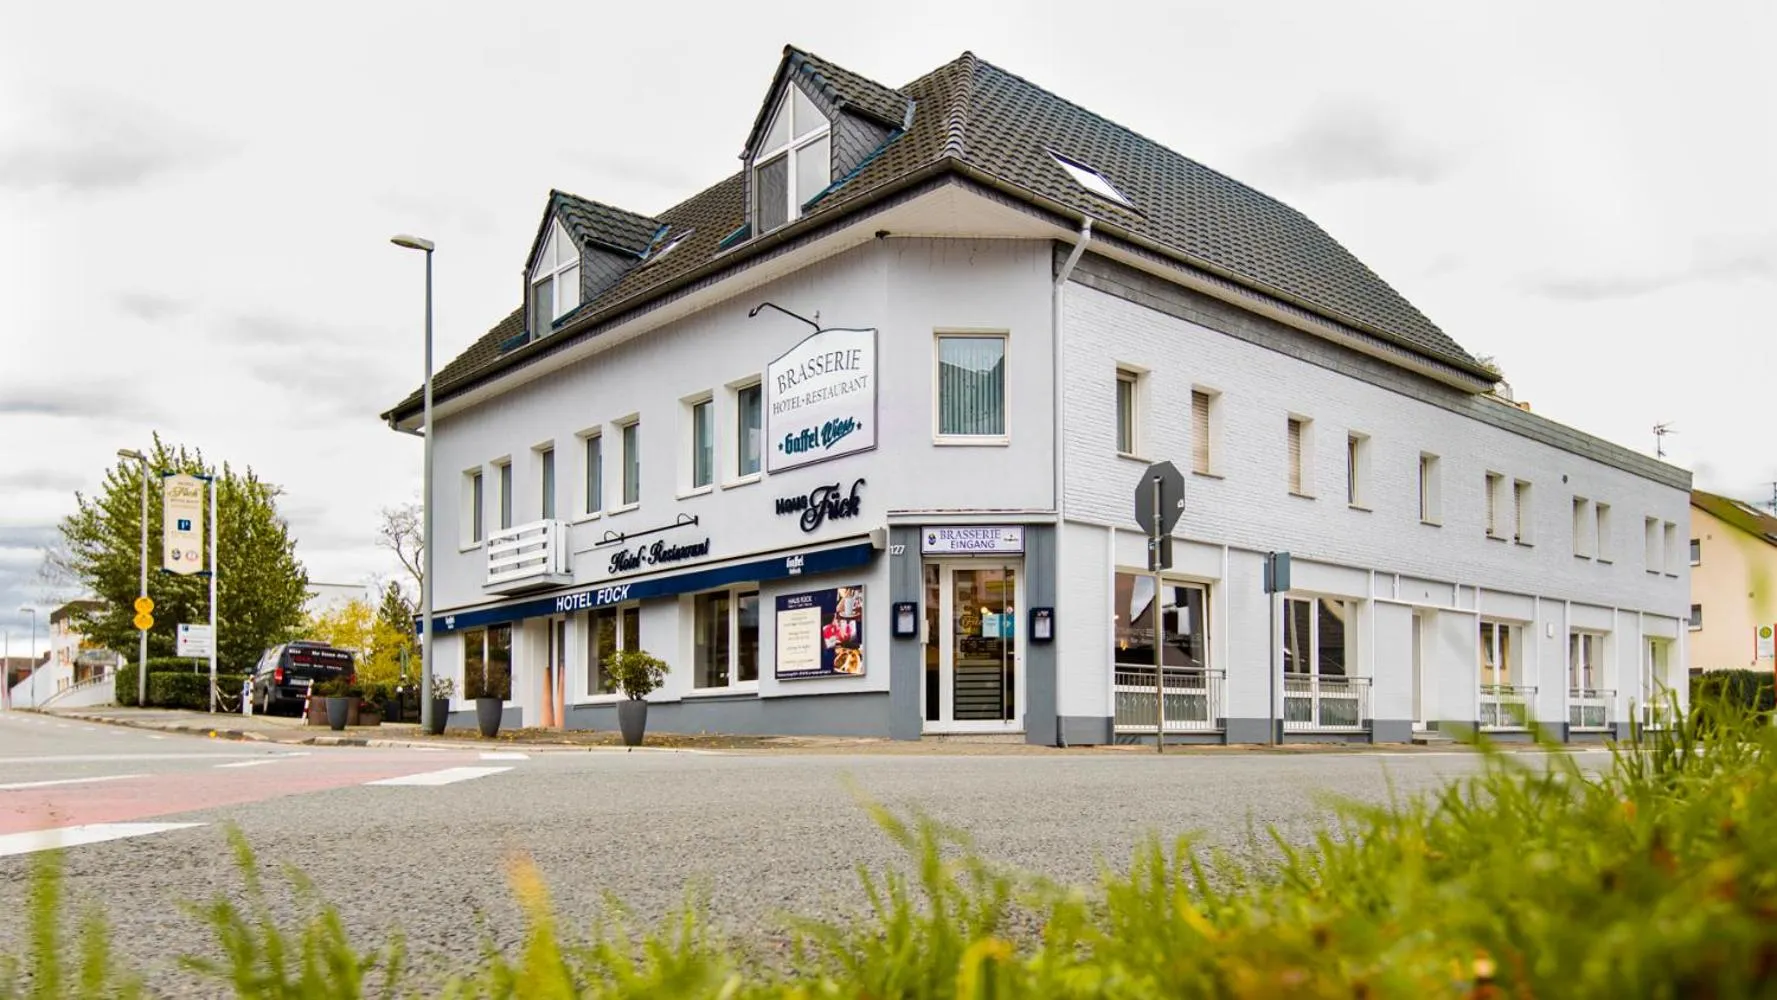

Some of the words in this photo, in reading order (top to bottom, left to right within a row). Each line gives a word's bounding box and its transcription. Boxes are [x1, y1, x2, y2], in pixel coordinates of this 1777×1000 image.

[777, 349, 862, 395] BRASSERIE
[784, 426, 820, 454] Gaffel
[940, 529, 1000, 540] BRASSERIE
[890, 544, 905, 555] 127
[950, 540, 995, 549] EINGANG
[556, 592, 592, 612] HOTEL
[597, 584, 631, 605] FÜCK
